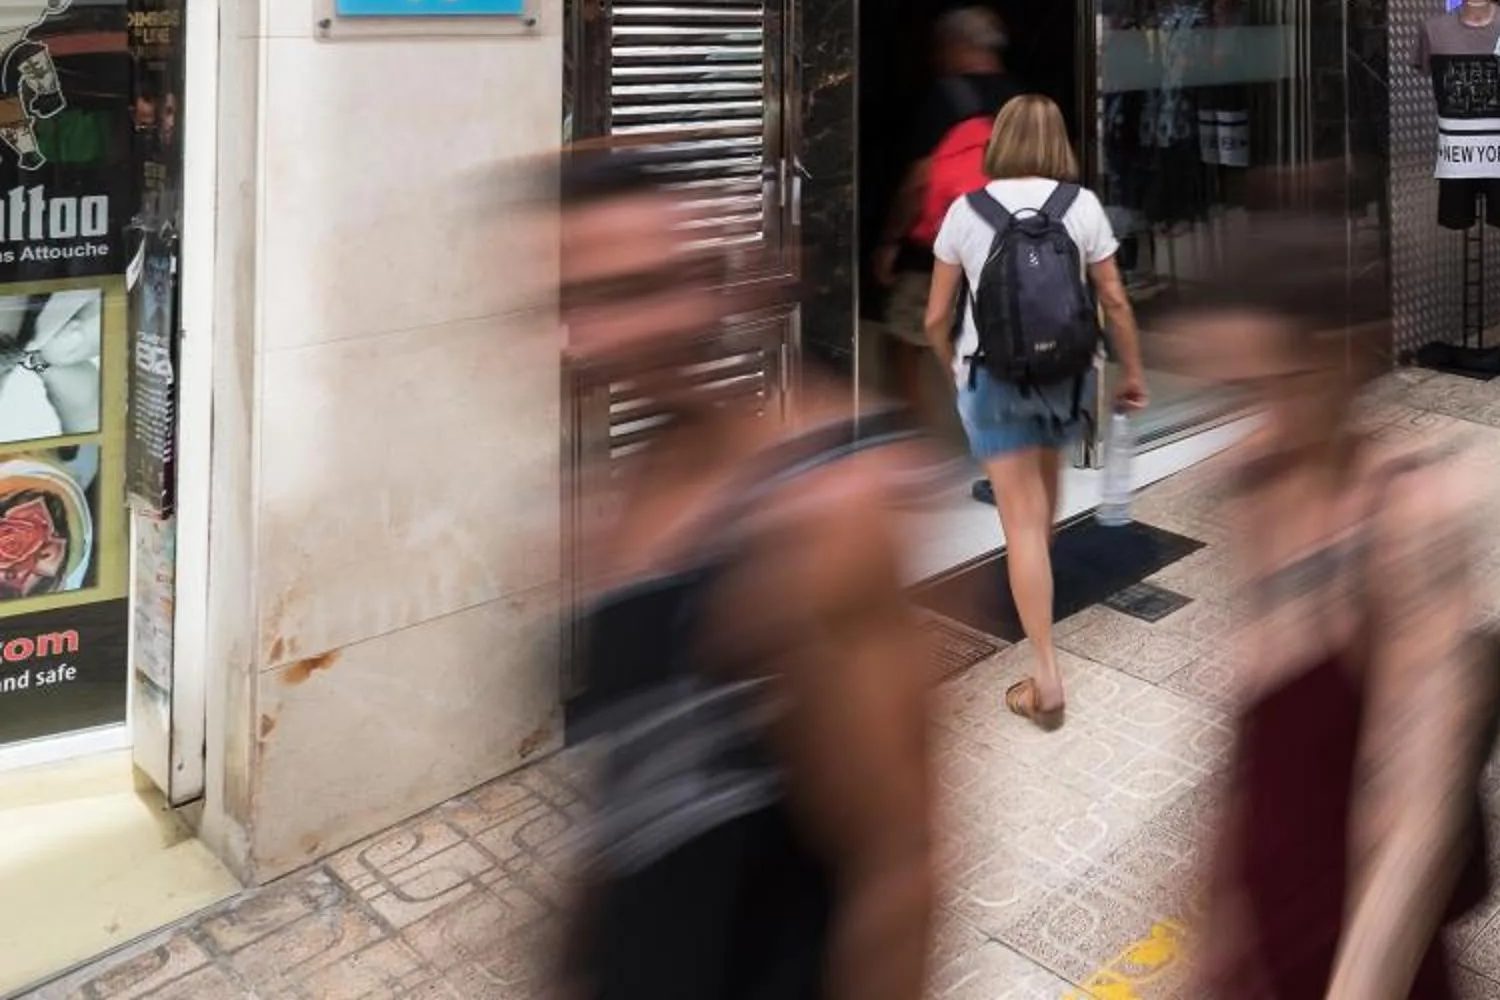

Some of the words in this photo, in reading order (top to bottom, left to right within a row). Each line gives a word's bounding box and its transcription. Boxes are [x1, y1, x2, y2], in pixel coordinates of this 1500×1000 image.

[1443, 145, 1473, 163] NEW
[0, 184, 109, 243] ttoo
[20, 242, 110, 262] Attouche
[0, 629, 79, 663] om
[0, 669, 30, 693] nd
[35, 662, 77, 687] safe
